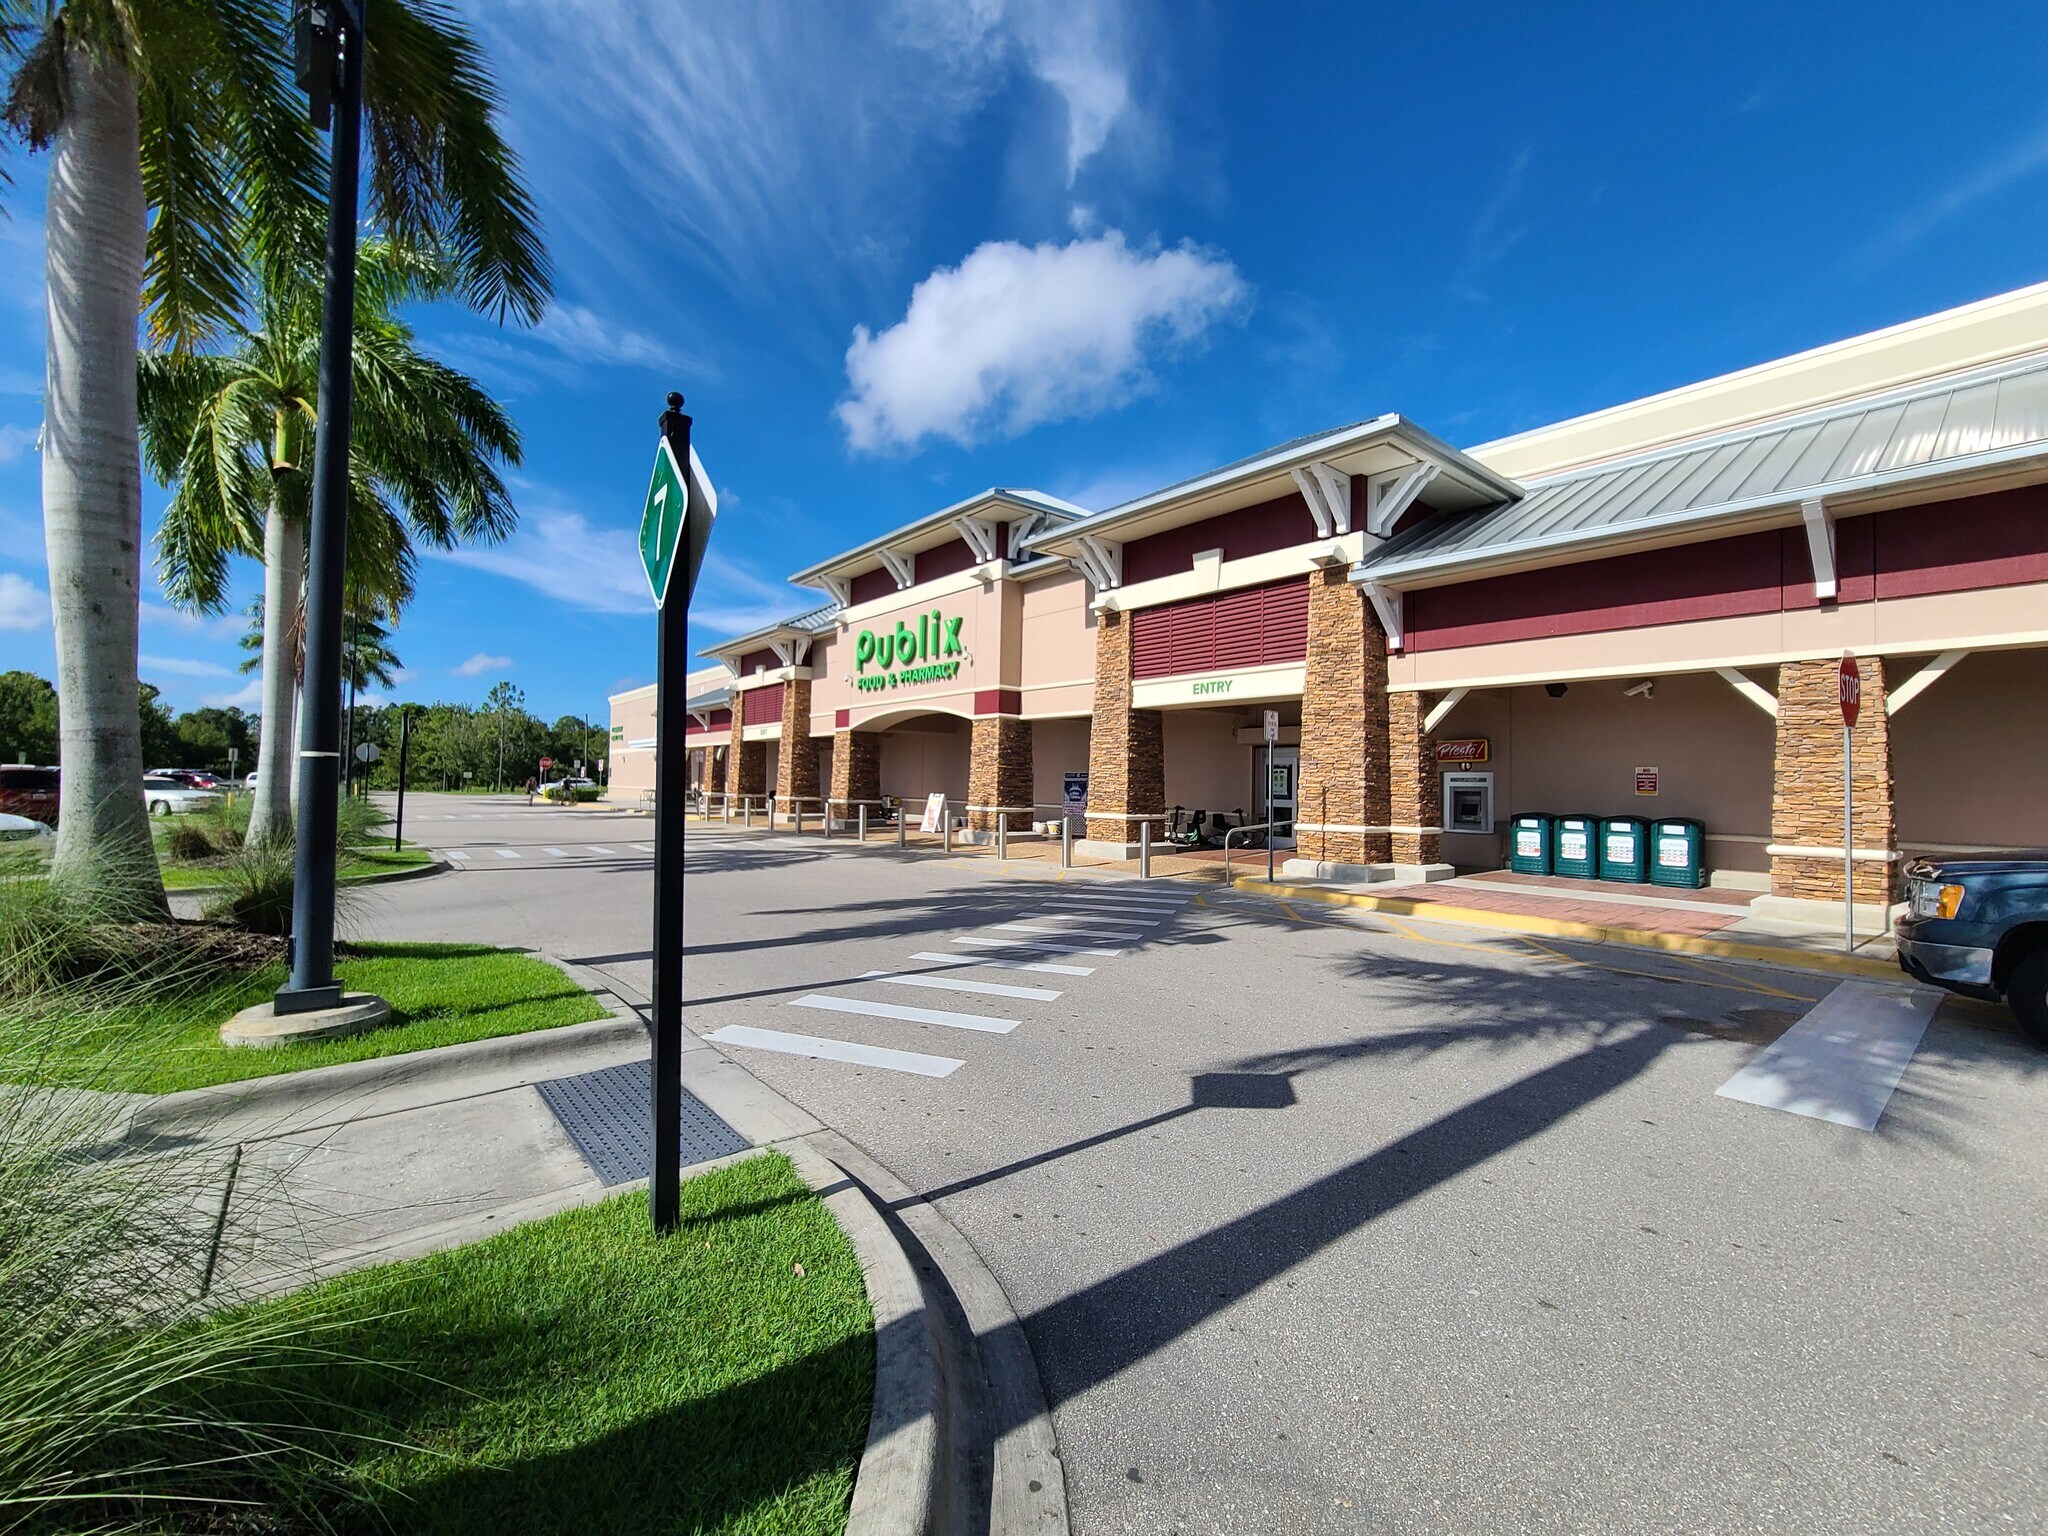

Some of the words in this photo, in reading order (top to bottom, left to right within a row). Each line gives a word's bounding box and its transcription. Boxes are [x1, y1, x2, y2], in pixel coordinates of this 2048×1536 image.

[856, 609, 963, 674] Publix
[857, 675, 885, 692] FOOD
[888, 673, 898, 688] &
[900, 661, 960, 683] PHARMACY
[1193, 680, 1233, 695] ENTRY
[1841, 674, 1860, 704] STOP
[1437, 742, 1485, 758] Presto!
